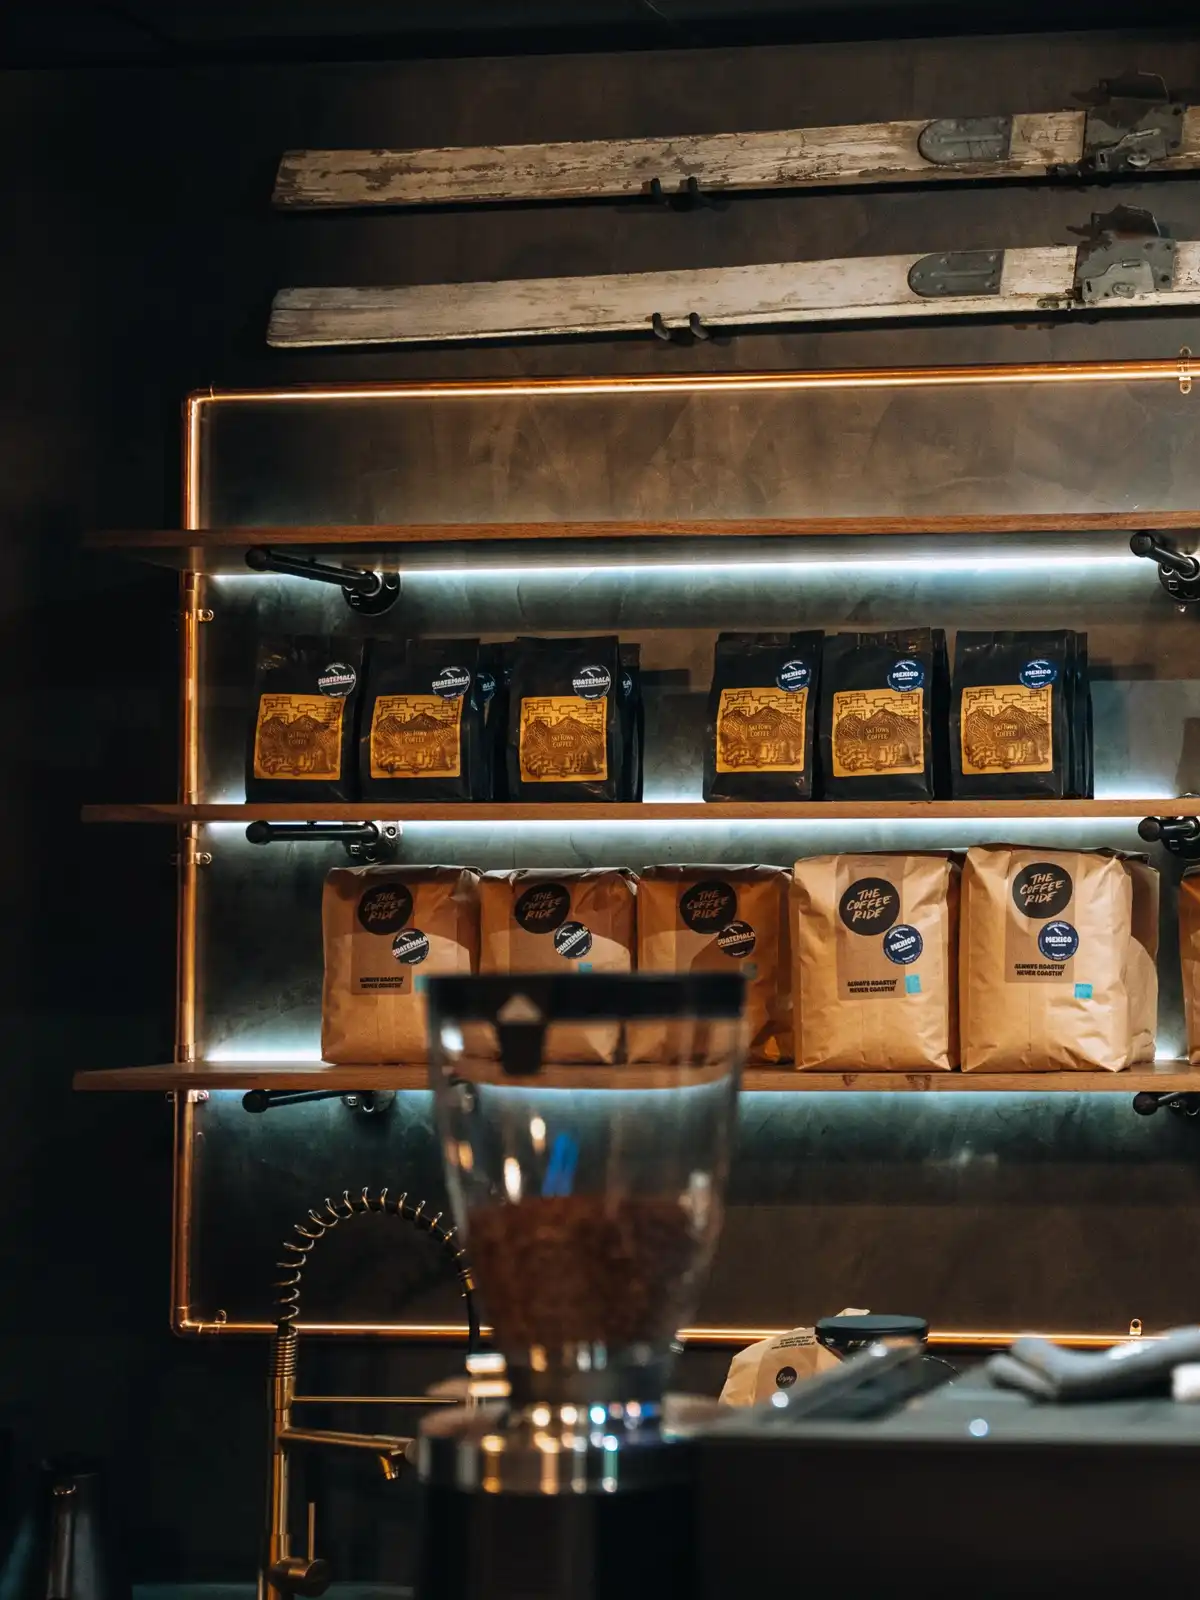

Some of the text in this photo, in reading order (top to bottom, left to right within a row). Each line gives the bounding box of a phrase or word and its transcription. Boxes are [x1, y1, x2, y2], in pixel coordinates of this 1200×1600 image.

[781, 669, 807, 680] MEXICO
[893, 670, 919, 679] MEXICO
[1024, 668, 1051, 677] MEXICO
[318, 674, 356, 685] GUATEMALA
[432, 675, 470, 688] GUATEMALA
[572, 676, 610, 688] GUATEMALA
[1031, 872, 1054, 884] THE
[857, 888, 881, 900] THE
[1020, 880, 1065, 895] COFFEE
[376, 892, 397, 902] THE
[532, 891, 554, 901] THE
[698, 890, 721, 901] THE
[1024, 891, 1058, 906] RIDE
[364, 899, 406, 912] COFFEE
[522, 897, 565, 911] COFFEE
[687, 896, 729, 910] COFFEE
[846, 895, 892, 911] COFFEE
[369, 909, 399, 922] RIDE
[525, 907, 556, 921] RIDE
[692, 907, 723, 921] RIDE
[852, 907, 885, 922] RIDE
[717, 931, 755, 946] GUATEMALA
[890, 936, 916, 952] MEXICO
[1045, 936, 1072, 944] MEXICO
[391, 936, 428, 956] GUATEMALA
